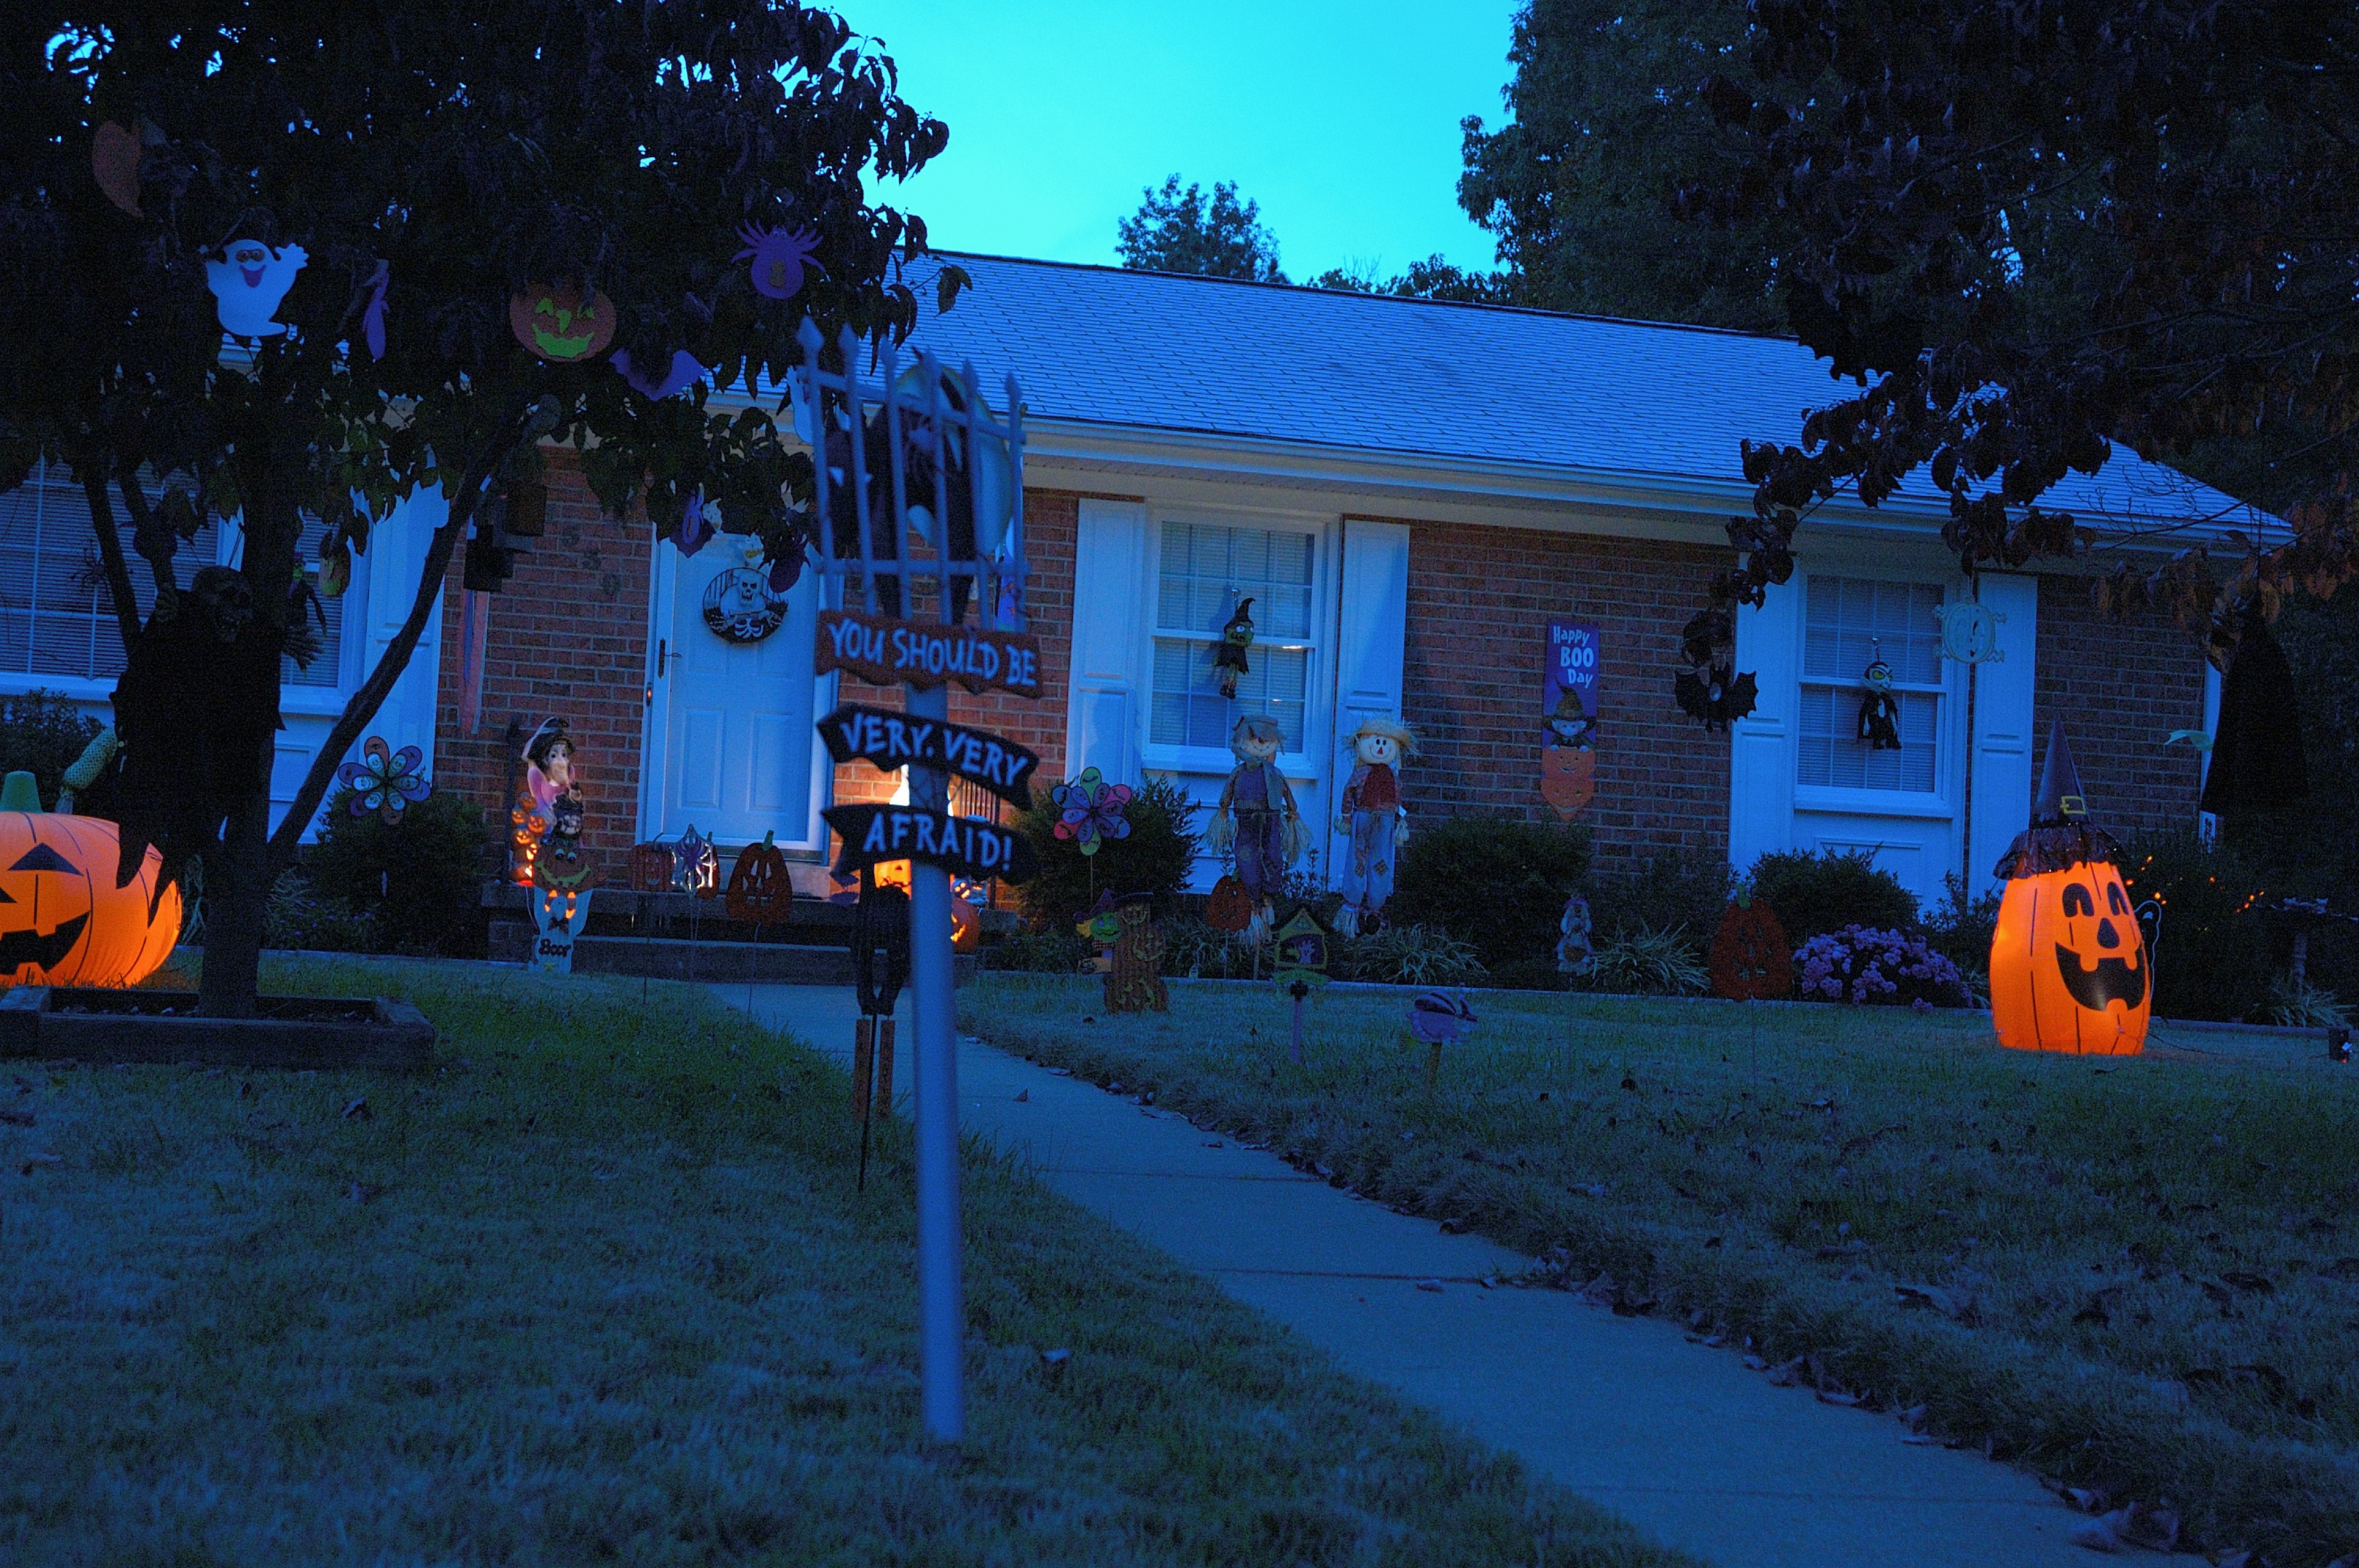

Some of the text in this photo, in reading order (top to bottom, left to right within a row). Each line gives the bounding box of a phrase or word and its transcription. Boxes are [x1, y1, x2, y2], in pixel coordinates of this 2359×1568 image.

[827, 617, 1038, 687] YOU SHOULD BE
[1553, 625, 1590, 647] Happy
[1560, 647, 1594, 668] BOO
[1567, 668, 1594, 689] Day
[942, 727, 1030, 787] VERY
[863, 811, 1014, 872] AFRAID!
